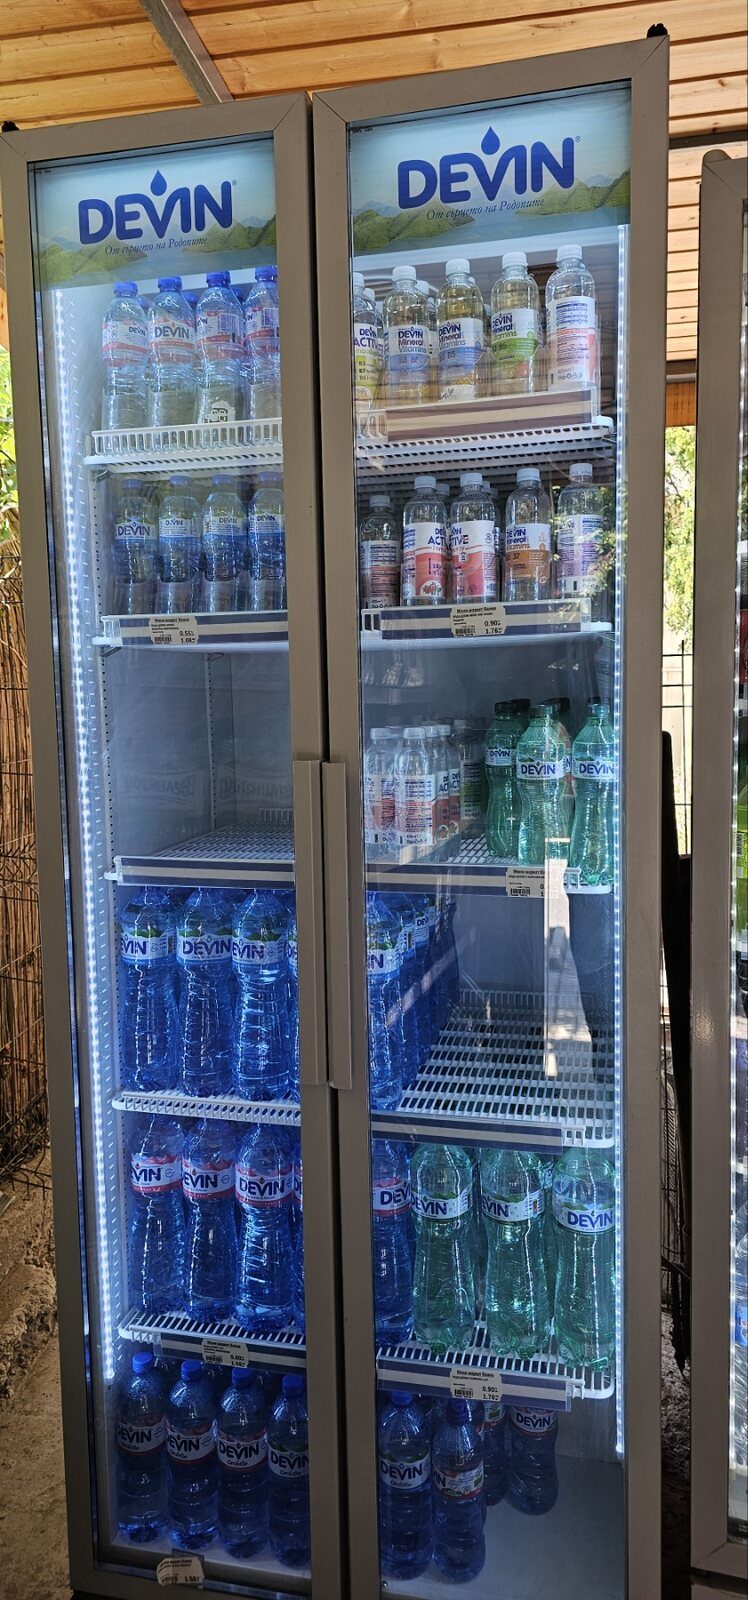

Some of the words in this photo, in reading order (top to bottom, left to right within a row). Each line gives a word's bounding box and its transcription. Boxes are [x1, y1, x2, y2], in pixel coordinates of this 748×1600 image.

[398, 137, 574, 209] DEVIN
[78, 181, 233, 245] DEVIN
[426, 209, 443, 220] От
[446, 206, 482, 220] сърцето
[485, 205, 497, 213] на
[500, 198, 545, 211] Родопите
[492, 314, 512, 328] EVIN
[154, 326, 190, 339] DEVIN
[398, 330, 424, 339] DEVIN
[118, 525, 150, 536] DEVIN
[521, 763, 556, 775] DEVIN
[580, 763, 615, 775] DEVIN
[120, 937, 147, 955] EVIN
[182, 937, 232, 955] DEVIN
[233, 941, 265, 959] EVIN
[184, 1172, 219, 1189] EVIN
[239, 1177, 285, 1196] DEVIN
[567, 1211, 613, 1229] DEVIN
[516, 1412, 551, 1429] DEVIN
[219, 1441, 260, 1461] DEVIN
[380, 1463, 423, 1481] DEVIN
